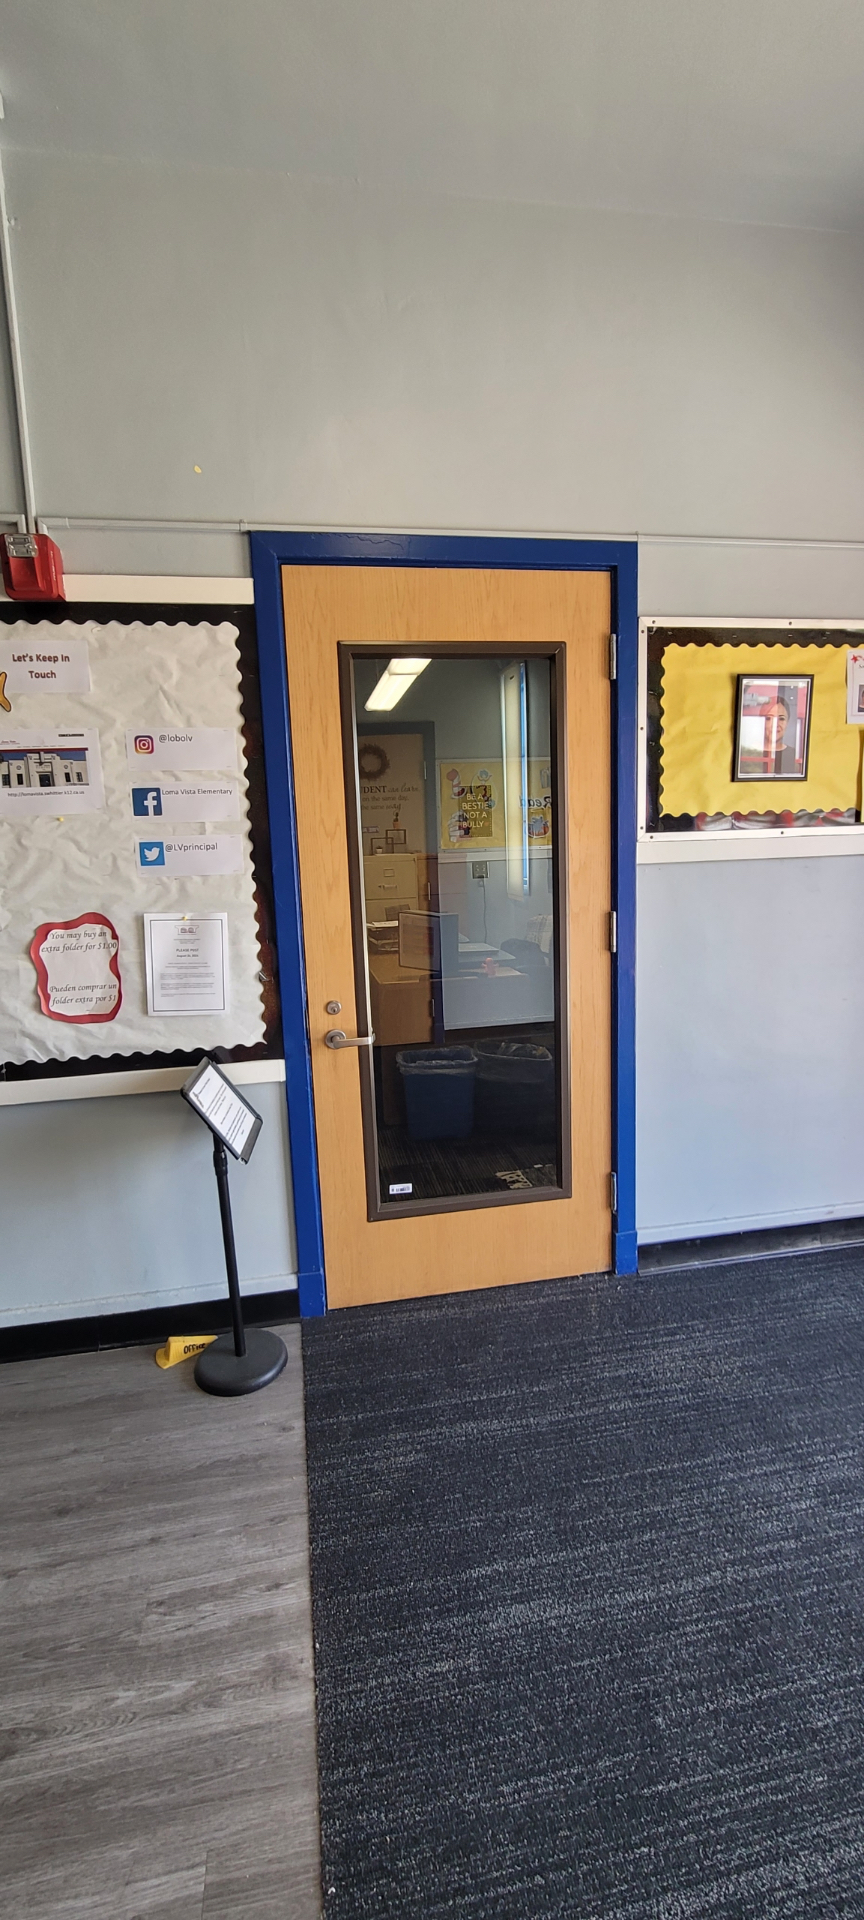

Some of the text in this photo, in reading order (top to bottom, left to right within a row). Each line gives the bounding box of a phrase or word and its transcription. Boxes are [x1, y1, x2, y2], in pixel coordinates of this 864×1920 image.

[36, 654, 58, 665] Keep
[61, 653, 70, 662] In
[28, 670, 57, 679] Touch
[158, 734, 193, 743] @lobolv
[197, 788, 233, 796] Elementary
[362, 785, 387, 793] DENT
[462, 802, 489, 810] BESTIE
[463, 811, 480, 819] NOT
[165, 842, 218, 853] @LVprincipal
[50, 931, 64, 940] You
[67, 932, 81, 941] may
[83, 930, 97, 939] buy
[41, 941, 117, 953] extra folder for $1.00
[49, 984, 76, 993] Pueden
[78, 984, 106, 993] comprar
[50, 994, 116, 1007] folder extra por $1
